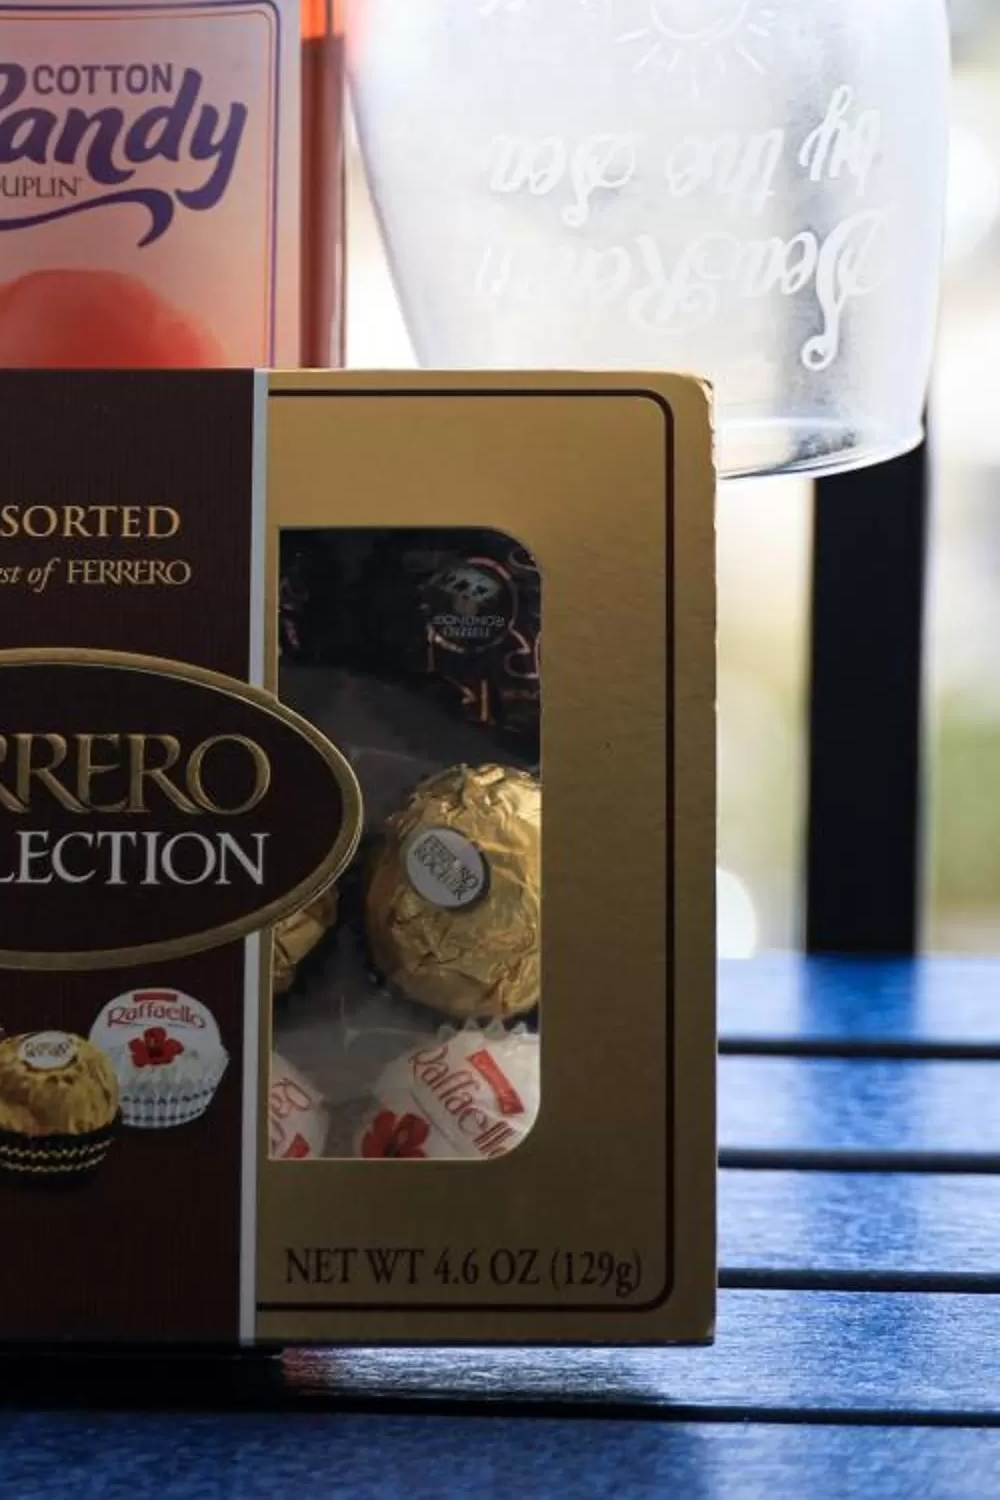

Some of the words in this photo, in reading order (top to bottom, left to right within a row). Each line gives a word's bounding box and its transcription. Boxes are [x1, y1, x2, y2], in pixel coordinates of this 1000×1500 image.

[32, 62, 172, 96] COTTON
[799, 84, 881, 197] by
[484, 132, 647, 228] Sea
[665, 127, 784, 213] the
[27, 557, 60, 593] of
[67, 559, 192, 586] FERRERO
[107, 1001, 206, 1029] Raffaello
[284, 1248, 358, 1285] NET
[364, 1248, 425, 1285] WT
[433, 1248, 480, 1285] 4.6
[490, 1248, 541, 1285] OZ
[550, 1248, 643, 1297] (129g)
